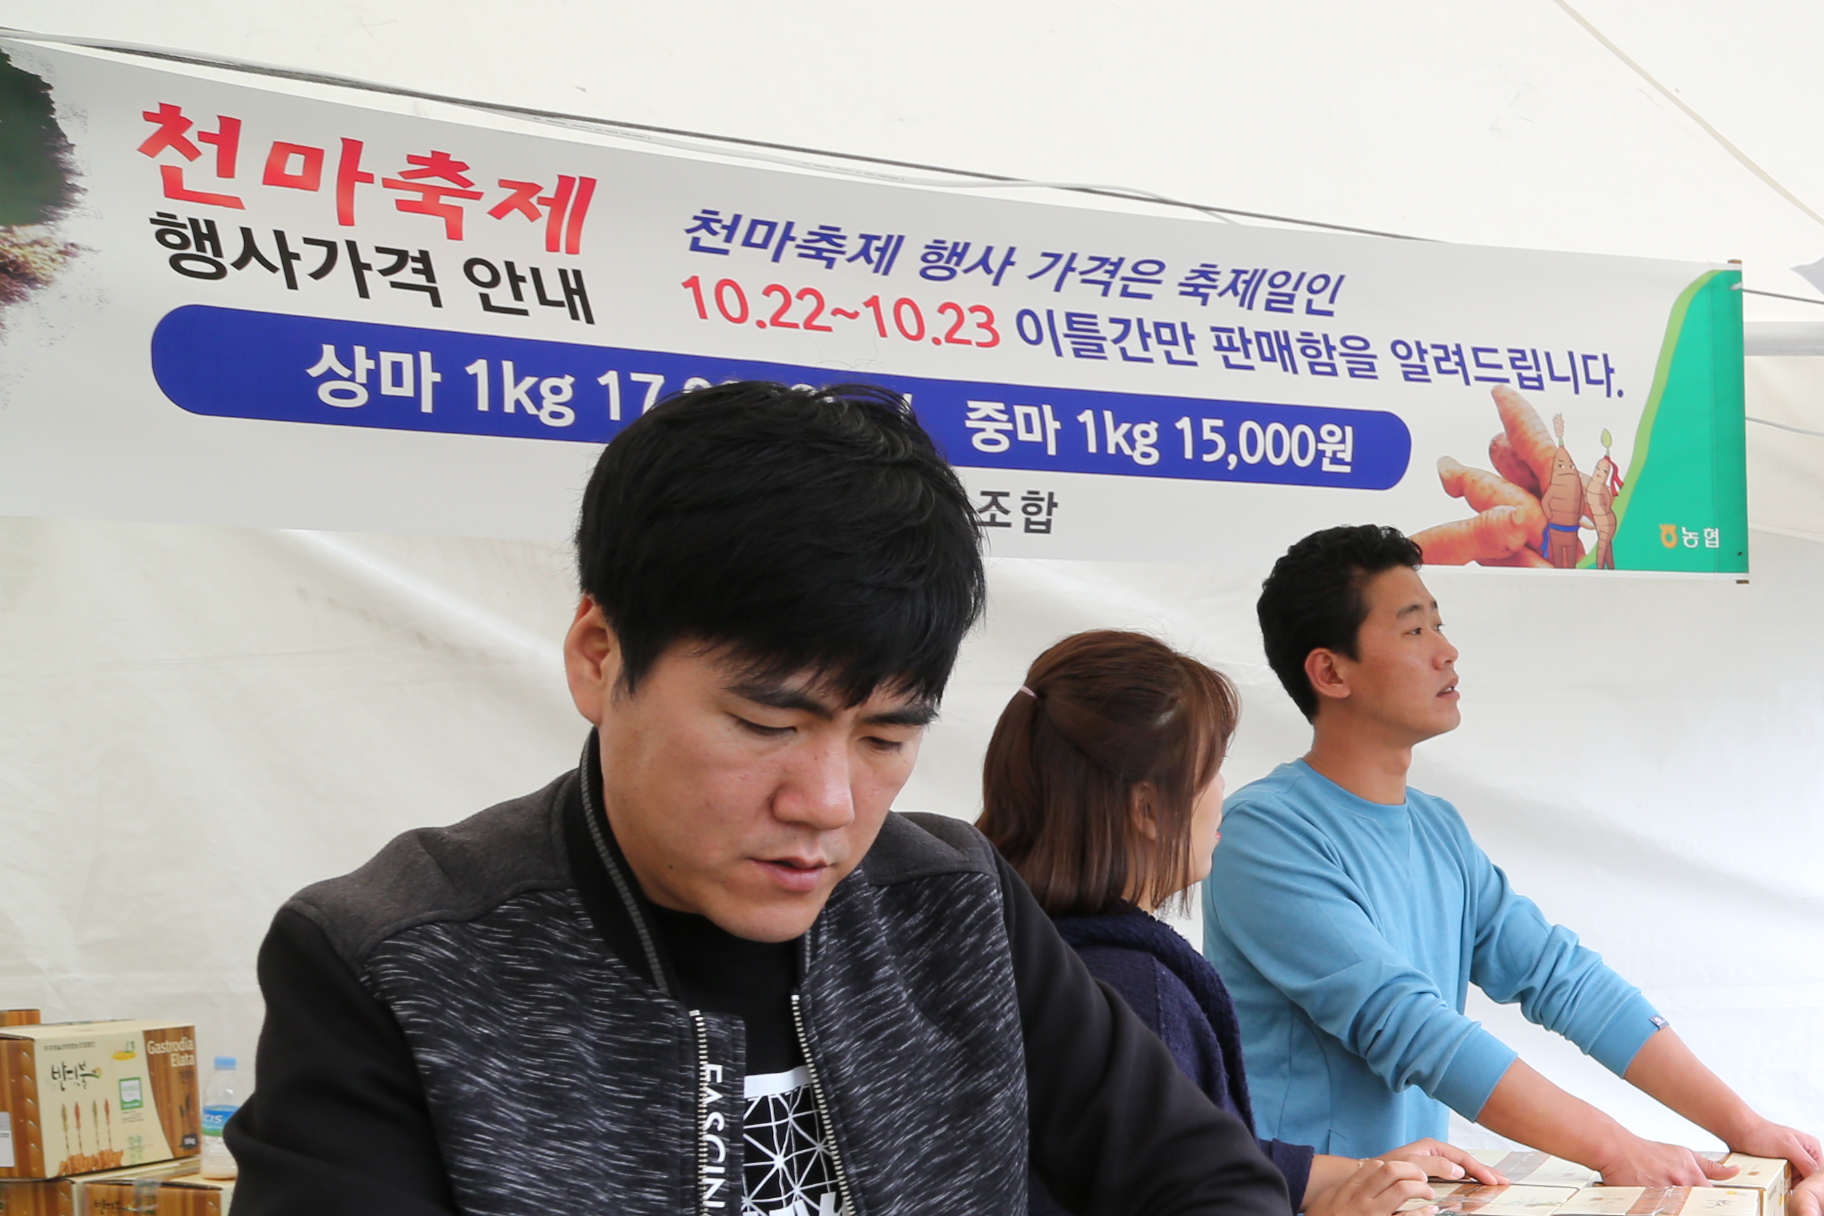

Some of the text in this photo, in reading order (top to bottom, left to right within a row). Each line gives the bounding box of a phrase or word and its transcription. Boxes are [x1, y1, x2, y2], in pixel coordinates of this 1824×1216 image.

[136, 101, 598, 256] 천마축제
[149, 210, 596, 326] 행사가격 안내
[682, 206, 1346, 320] 천마축제 행사 가격은 축제일인
[681, 272, 1625, 399] 10.22~10.23 이틀간만 판매함을 알려드립니다.
[306, 340, 443, 416] 상마
[465, 357, 577, 429] 1kg
[964, 399, 1355, 474] 중마 1kg 15,000원
[1681, 524, 1721, 551] 농협
[147, 1036, 195, 1055] Gastrodia
[171, 1052, 195, 1067] Elata
